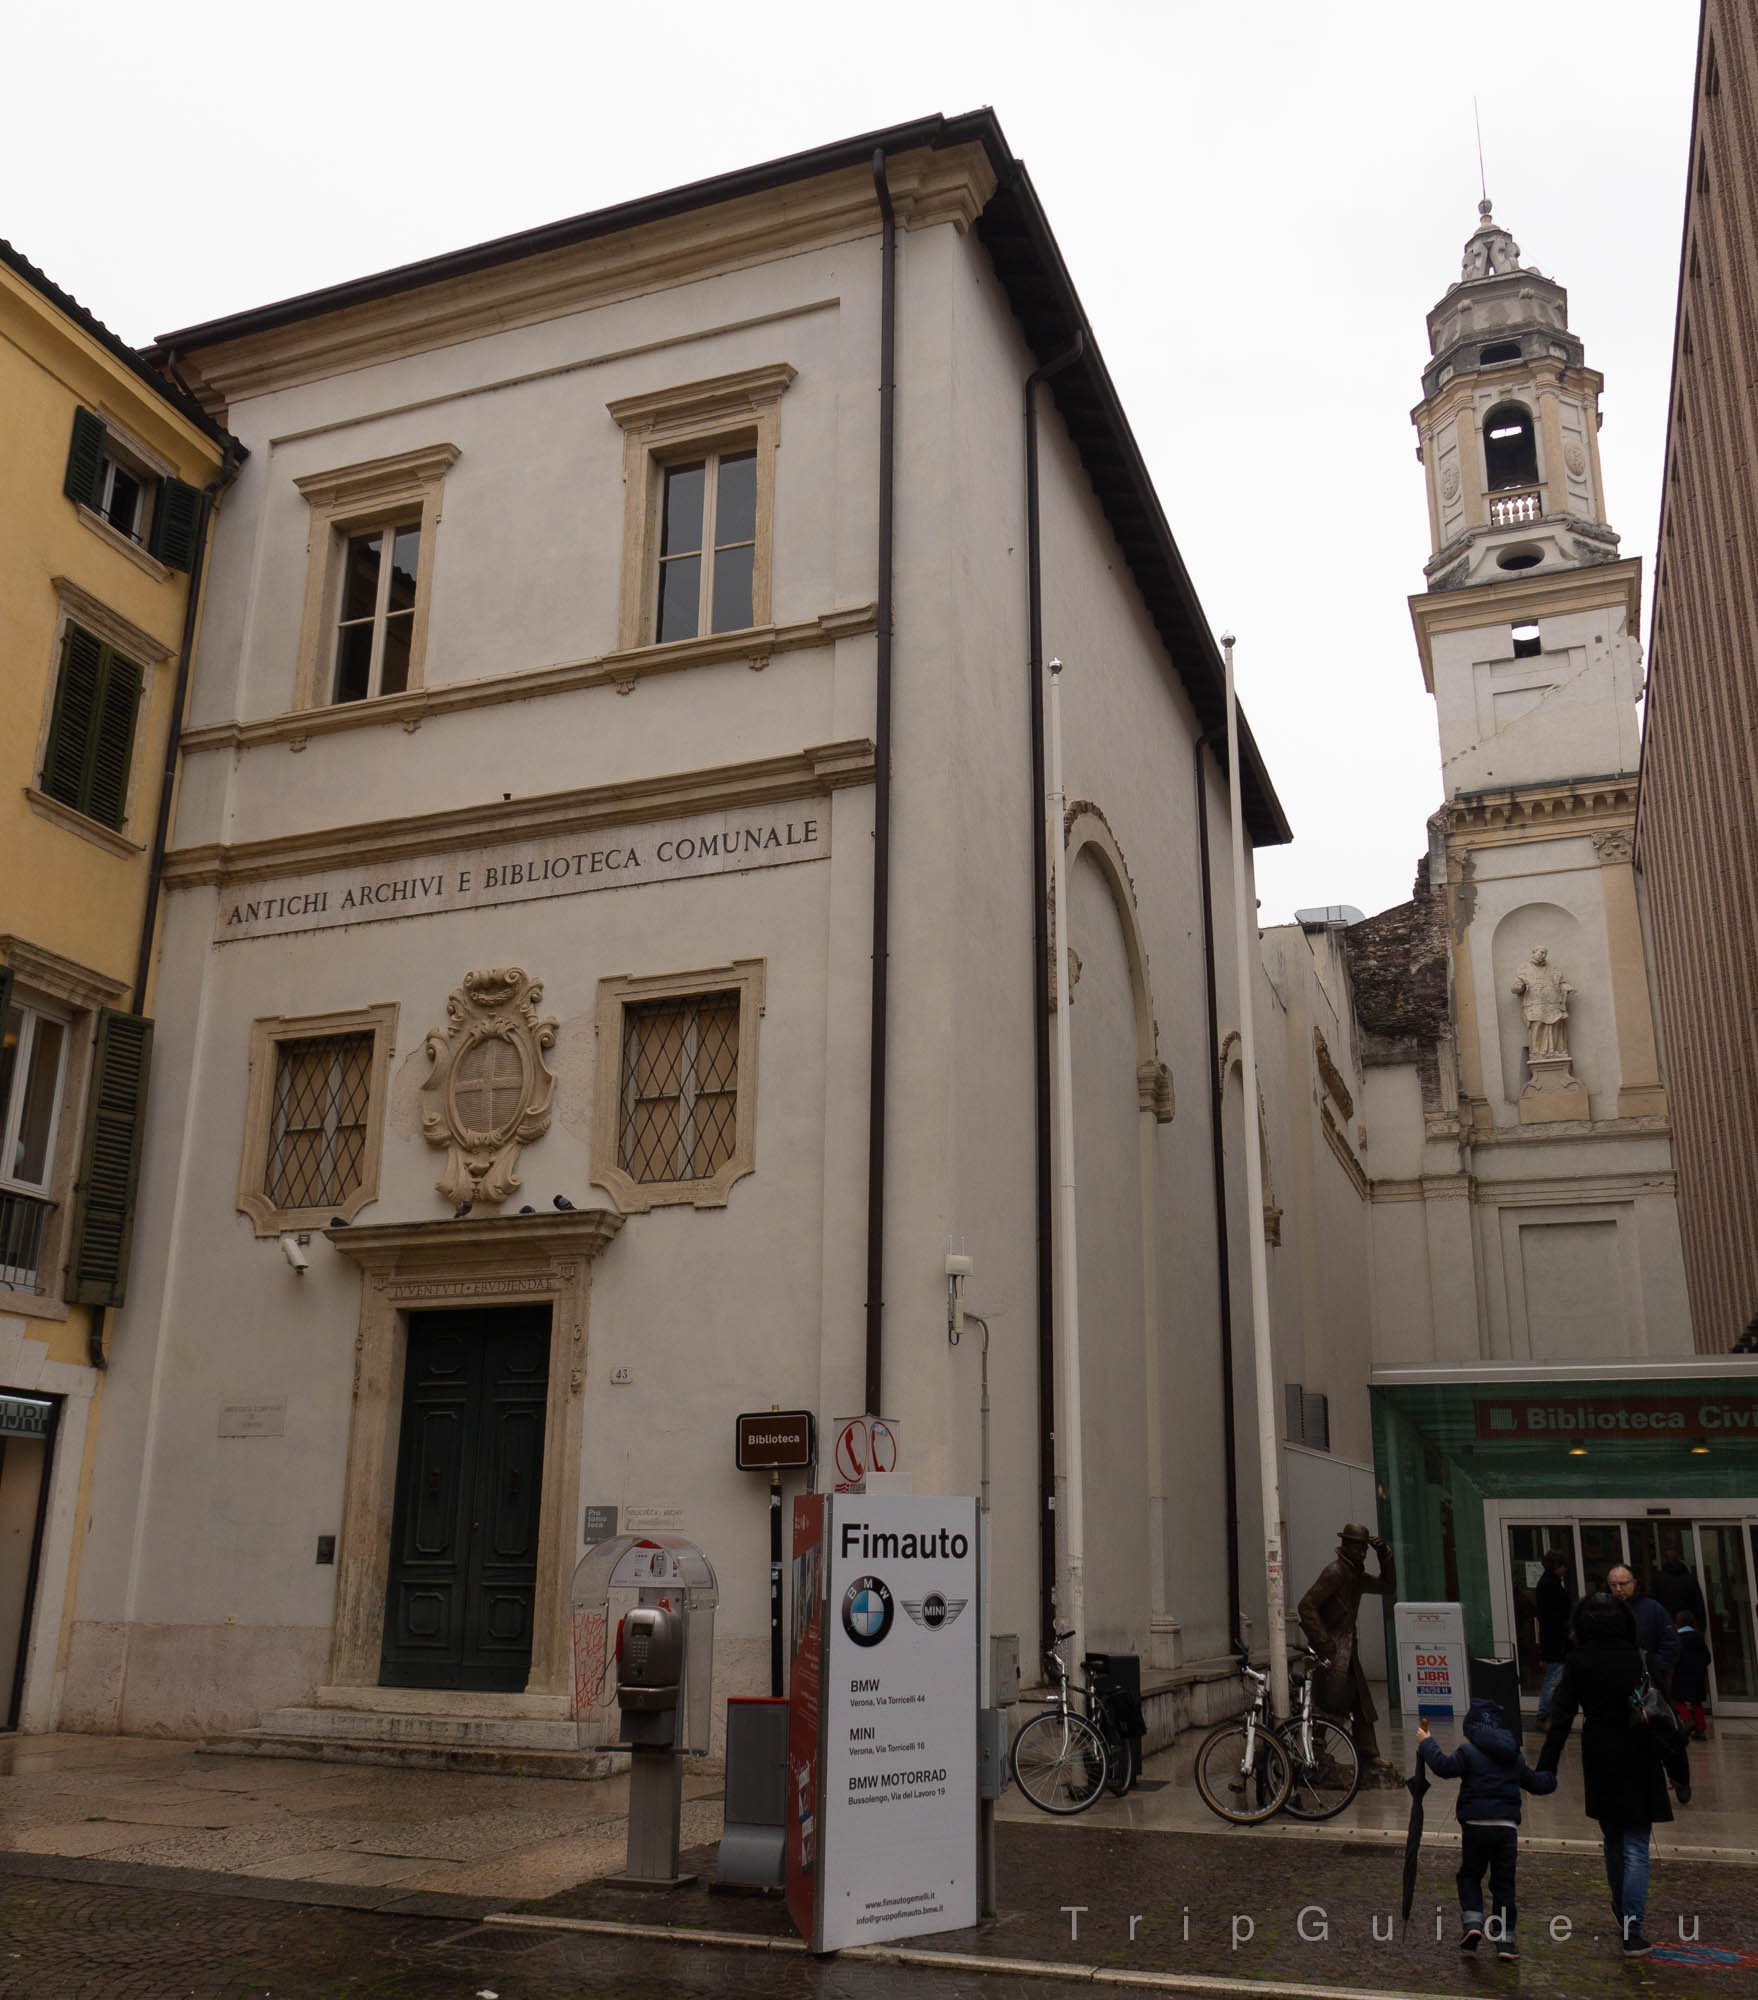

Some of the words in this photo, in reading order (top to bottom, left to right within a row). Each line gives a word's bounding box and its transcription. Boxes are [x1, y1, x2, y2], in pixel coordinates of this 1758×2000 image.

[226, 892, 328, 926] ANTICHI
[340, 875, 443, 910] ARCHIVI
[458, 872, 472, 892] E
[484, 847, 640, 888] BIBLIOTECA
[657, 820, 819, 863] COMUNALE
[1526, 1407, 1686, 1430] Biblioteca
[748, 1433, 800, 1445] Biblioteca
[842, 1523, 968, 1558] Fimauto
[847, 1578, 890, 1600] BMW
[924, 1605, 945, 1617] MINI
[1416, 1655, 1449, 1666] BOX
[1416, 1671, 1450, 1681] LIBRI
[850, 1679, 880, 1693] BMW
[850, 1698, 875, 1708] Verona,
[876, 1696, 887, 1706] Via
[888, 1695, 916, 1705] Torricelli
[849, 1727, 875, 1741] MINI
[849, 1747, 874, 1756] Verona,
[875, 1745, 886, 1754] Via
[887, 1742, 916, 1753] Torricelli
[849, 1775, 878, 1790] BMW
[881, 1768, 947, 1787] MOTORRAD
[890, 1791, 901, 1801] Via
[902, 1790, 912, 1799] del
[914, 1788, 936, 1799] Lavoro
